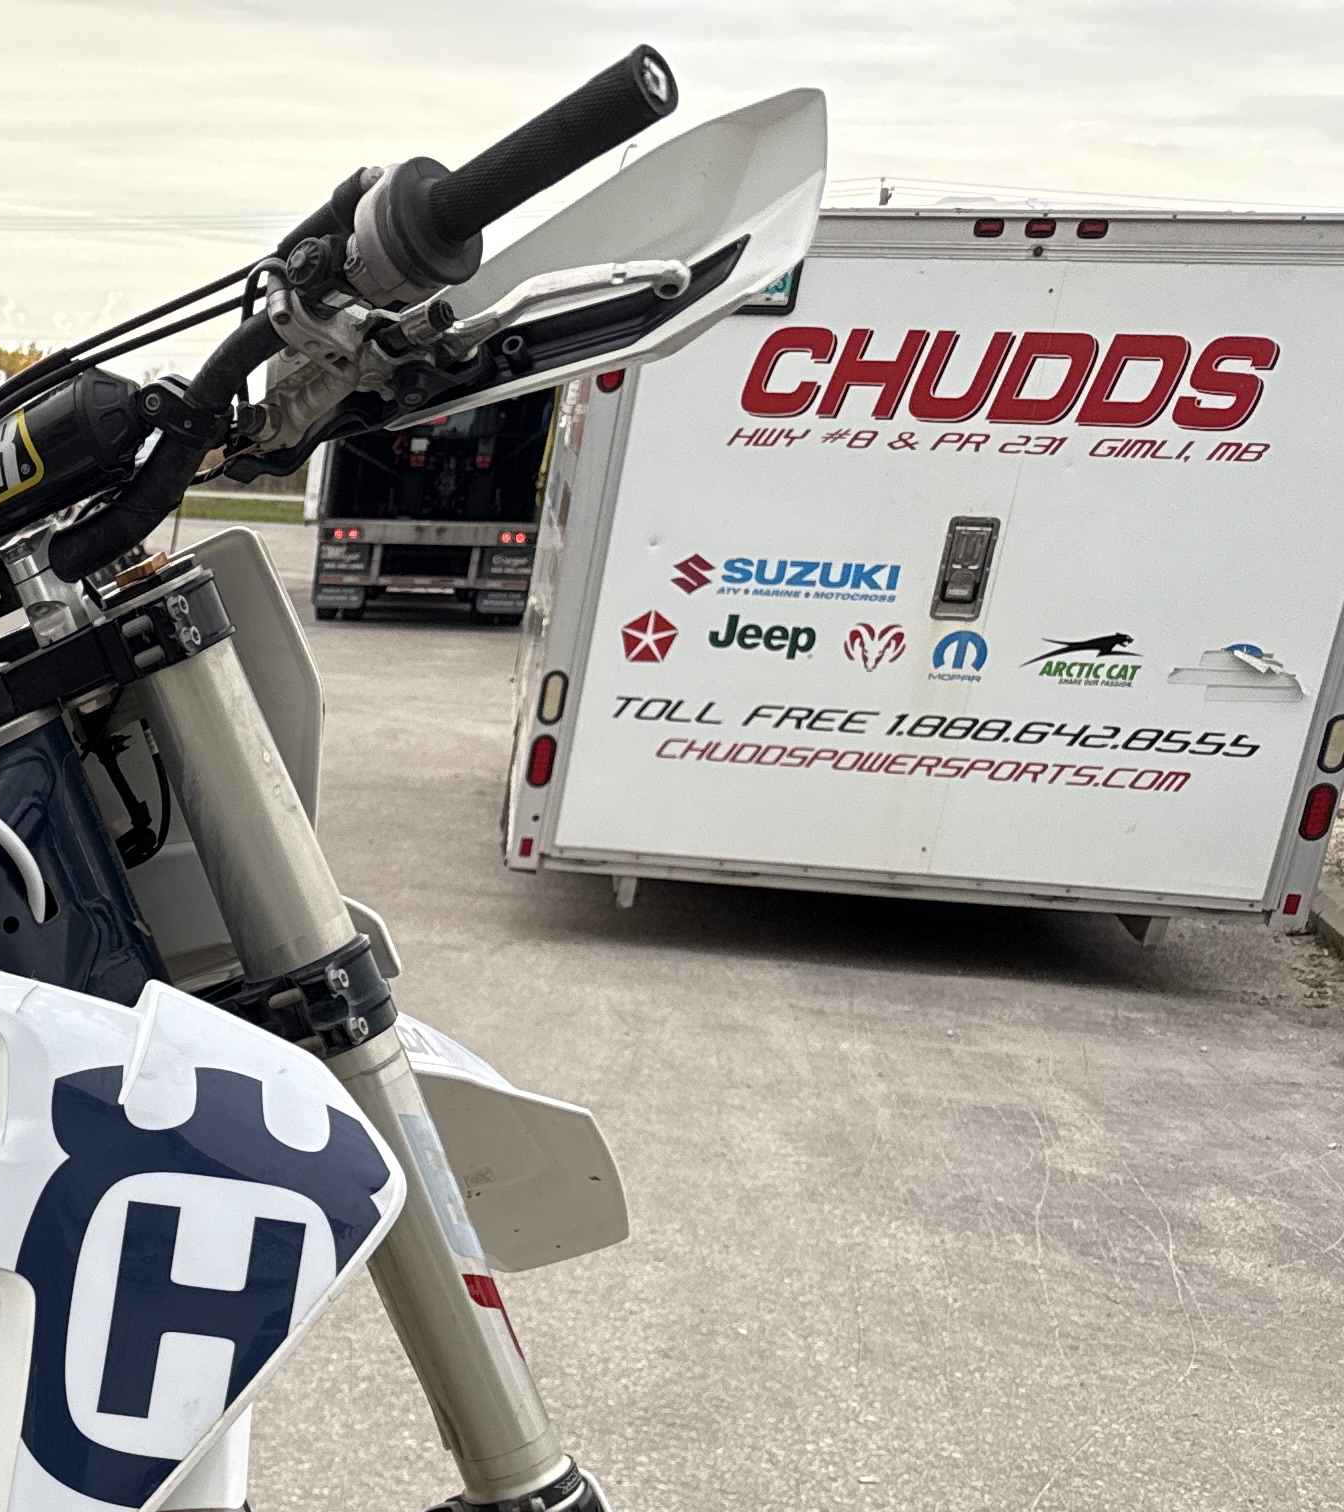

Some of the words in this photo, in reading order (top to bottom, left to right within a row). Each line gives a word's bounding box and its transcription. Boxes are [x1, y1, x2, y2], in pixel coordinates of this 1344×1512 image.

[741, 327, 1280, 431] CHUDDS
[727, 428, 810, 447] HWY
[821, 430, 873, 450] #8
[888, 432, 918, 451] &
[931, 433, 989, 453] PR
[999, 436, 1069, 456] 231
[1089, 438, 1191, 463] GIMLI,
[1208, 443, 1271, 463] MB
[721, 557, 902, 591] SUZUKI
[716, 587, 741, 595] ATV
[752, 588, 802, 599] MARINE
[813, 591, 897, 603] MOTOCROSS
[708, 614, 816, 660] Jeep
[928, 673, 981, 682] MOPAR
[1039, 660, 1108, 680] ARCTIC
[1108, 663, 1142, 682] CAT
[613, 695, 722, 725] TOLL
[742, 704, 880, 734] FREE
[886, 713, 1260, 758] 1.888.642.8555
[655, 738, 1192, 792] CHUDDSPOWERSPORTS.COM
